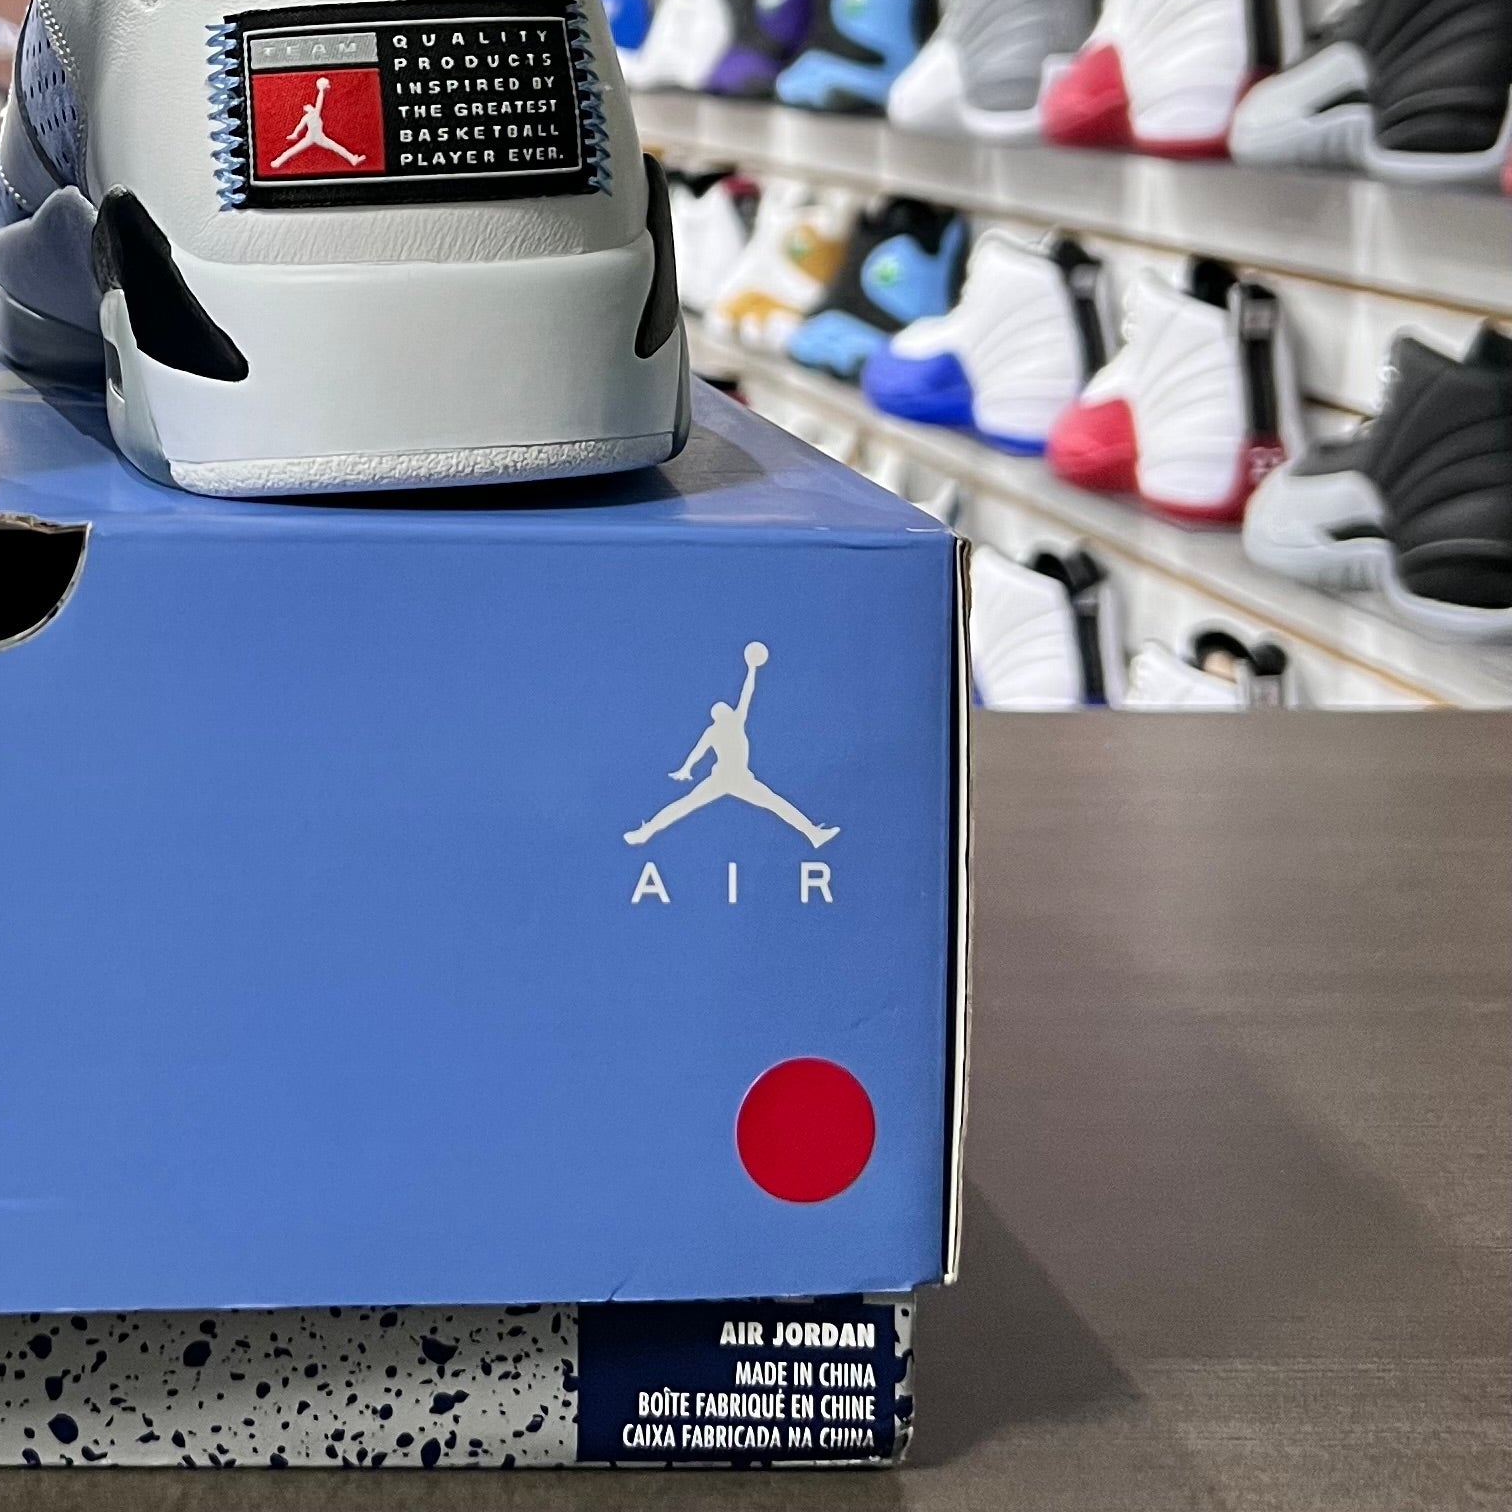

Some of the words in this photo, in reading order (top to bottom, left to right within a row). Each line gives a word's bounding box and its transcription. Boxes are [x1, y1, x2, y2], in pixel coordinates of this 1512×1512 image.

[392, 30, 548, 49] QUALITY
[262, 42, 357, 57] TEAM
[394, 54, 552, 71] PRODUCTS
[396, 76, 520, 95] INSPIRED
[532, 76, 555, 89] BY
[398, 104, 442, 118] THE
[455, 100, 557, 117] GREATEST
[399, 124, 559, 143] BASKETBALL
[400, 150, 495, 166] PLAYER
[509, 147, 565, 161] EVER.
[631, 861, 833, 904] AIR
[719, 1321, 764, 1346] AIR
[772, 1322, 875, 1348] JORDAN
[735, 1361, 787, 1386] MADE
[793, 1362, 813, 1387] IN
[819, 1362, 876, 1388] CHINA
[638, 1387, 690, 1418] BOÎTE
[696, 1388, 785, 1419] FABRIQUÉ
[791, 1394, 813, 1419] EN
[820, 1394, 875, 1420] CHINE
[622, 1423, 676, 1447] CAIXA
[682, 1425, 781, 1448] FABRICADA
[788, 1426, 813, 1448] NA
[819, 1427, 875, 1448] CHINA
